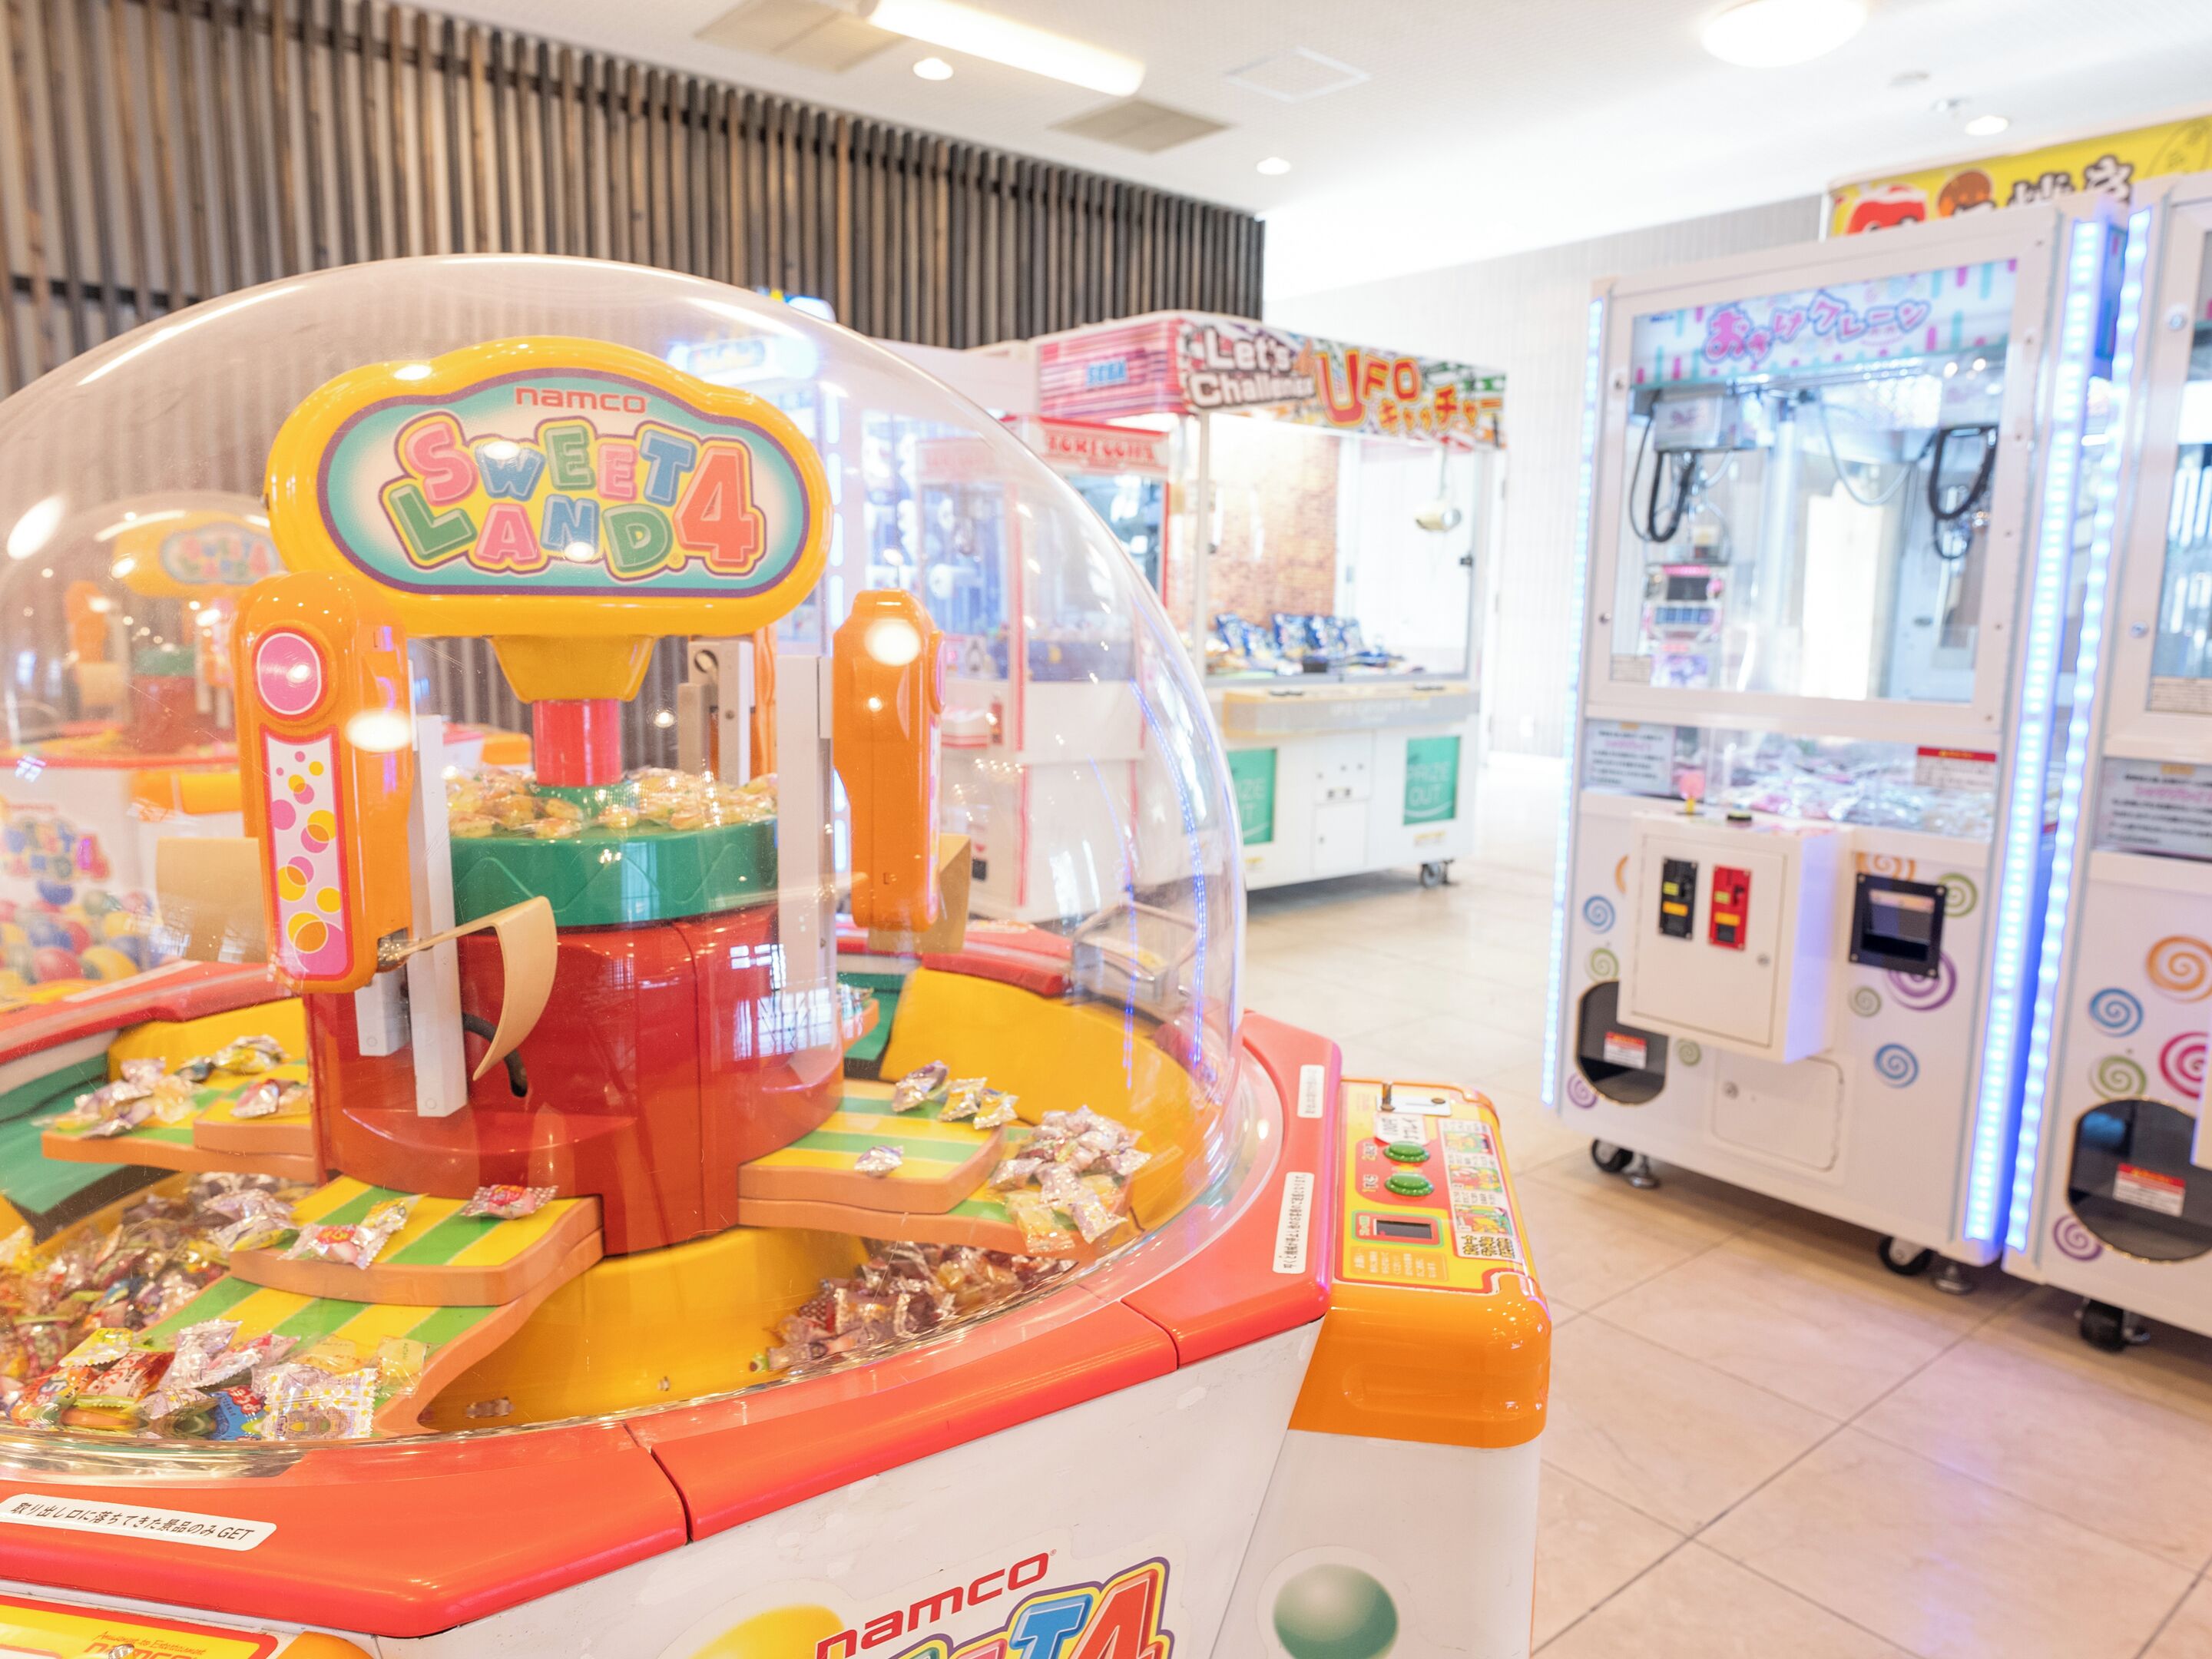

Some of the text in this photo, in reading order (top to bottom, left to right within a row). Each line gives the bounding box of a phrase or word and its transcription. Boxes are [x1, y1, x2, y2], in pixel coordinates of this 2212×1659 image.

[1204, 326, 1293, 373] Let's
[515, 386, 646, 414] namco
[1314, 350, 1421, 427] UFO
[403, 422, 697, 507] SWEET
[387, 482, 674, 574] LAND
[672, 445, 759, 571] 4
[10, 1502, 255, 1541] 取り出し口に落ちてきた景品のみ GET
[816, 1552, 1050, 1659] namco
